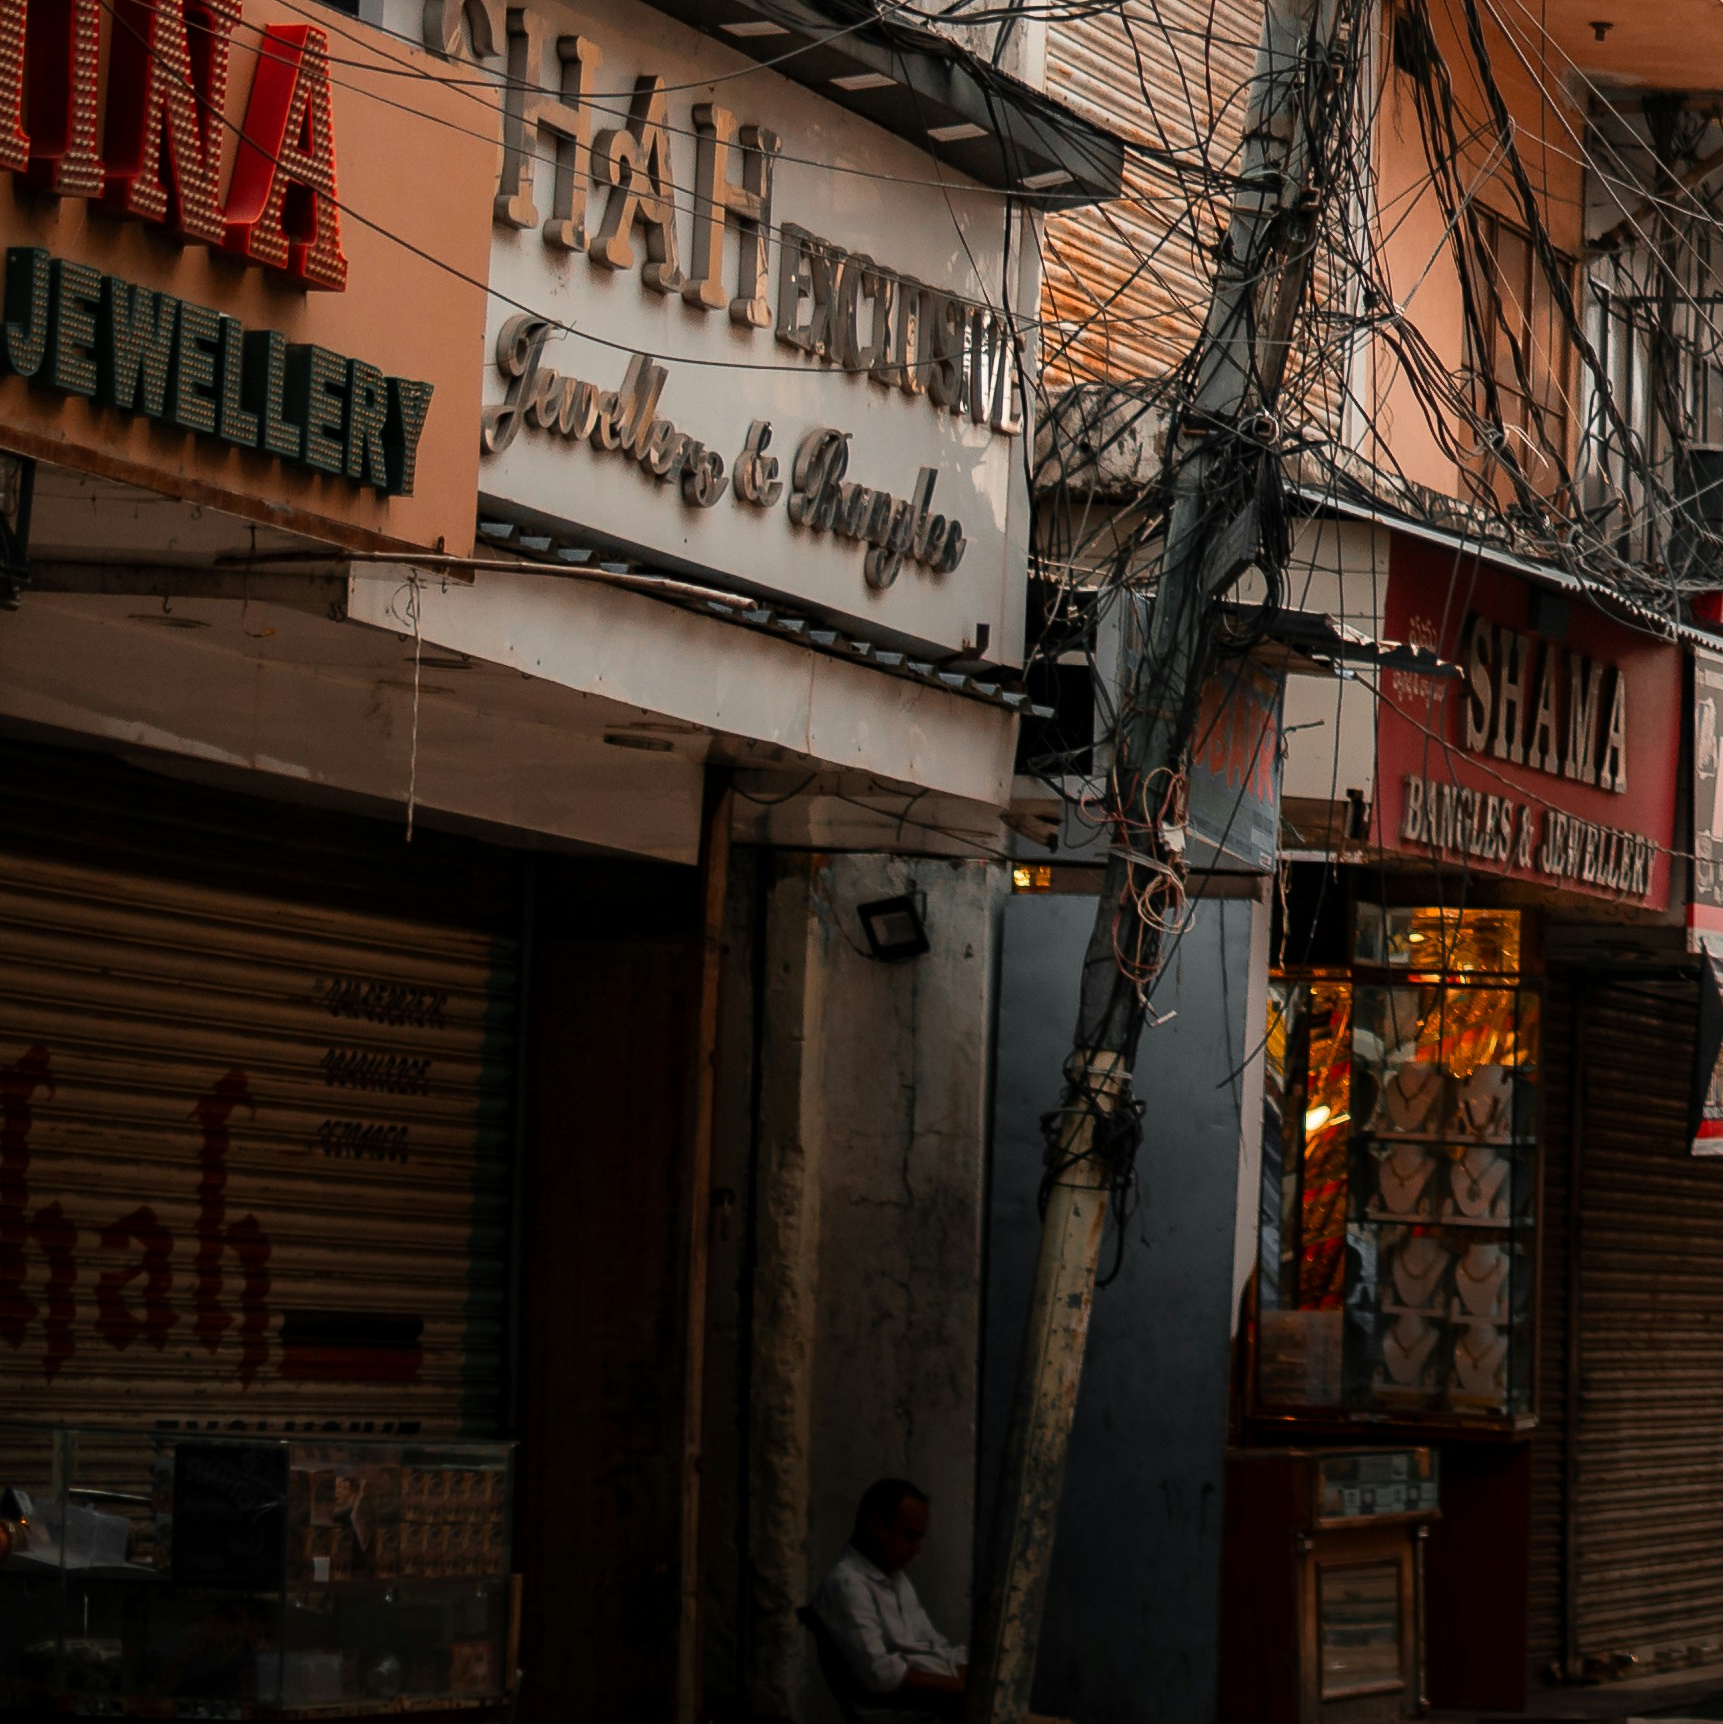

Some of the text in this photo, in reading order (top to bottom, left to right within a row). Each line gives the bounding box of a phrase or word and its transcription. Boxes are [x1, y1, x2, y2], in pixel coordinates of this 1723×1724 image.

[4, 246, 434, 498] JEWELLERY
[1467, 617, 1627, 794] SHAMA
[1403, 775, 1514, 862] BANGLES
[1519, 806, 1535, 869] &
[1542, 810, 1659, 896] JEWELLERY
